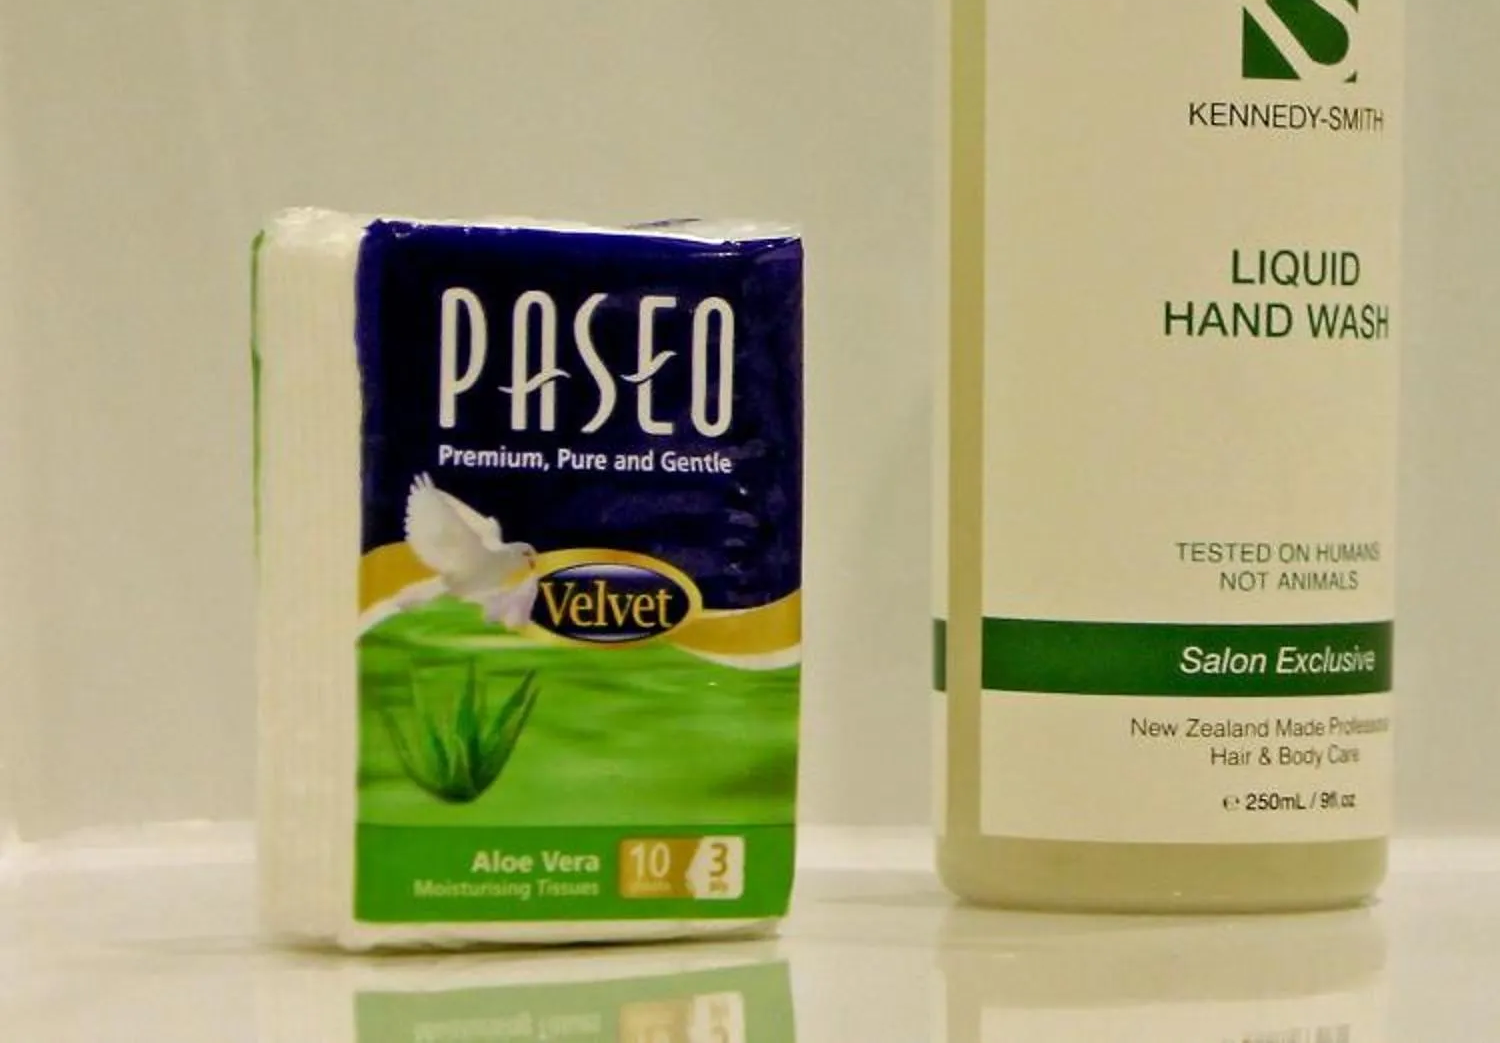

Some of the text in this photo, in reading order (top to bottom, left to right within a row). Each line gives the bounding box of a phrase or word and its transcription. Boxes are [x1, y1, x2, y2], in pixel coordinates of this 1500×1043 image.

[1188, 101, 1384, 132] KENNEDY-SMITH
[1231, 248, 1361, 287] LIQUID
[1164, 300, 1390, 340] HAND WASH
[438, 286, 735, 437] PASEO
[437, 443, 733, 475] Premium, Pure and Gentle
[1176, 540, 1381, 564] TESTED ON HUMANS
[1220, 570, 1359, 592] NOT ANIMALS
[539, 580, 673, 628] Velvet
[1179, 644, 1376, 674] Salon Exclusive
[1130, 717, 1179, 738] New
[1185, 717, 1269, 738] Zealand
[1275, 718, 1325, 738] Made
[1210, 743, 1361, 769] Hair & Body Care
[1245, 792, 1307, 811] 250mL
[470, 850, 602, 874] Aloe Vera
[629, 841, 671, 878] 10
[708, 841, 728, 878] 3
[412, 878, 600, 902] Moisturising Tissues
